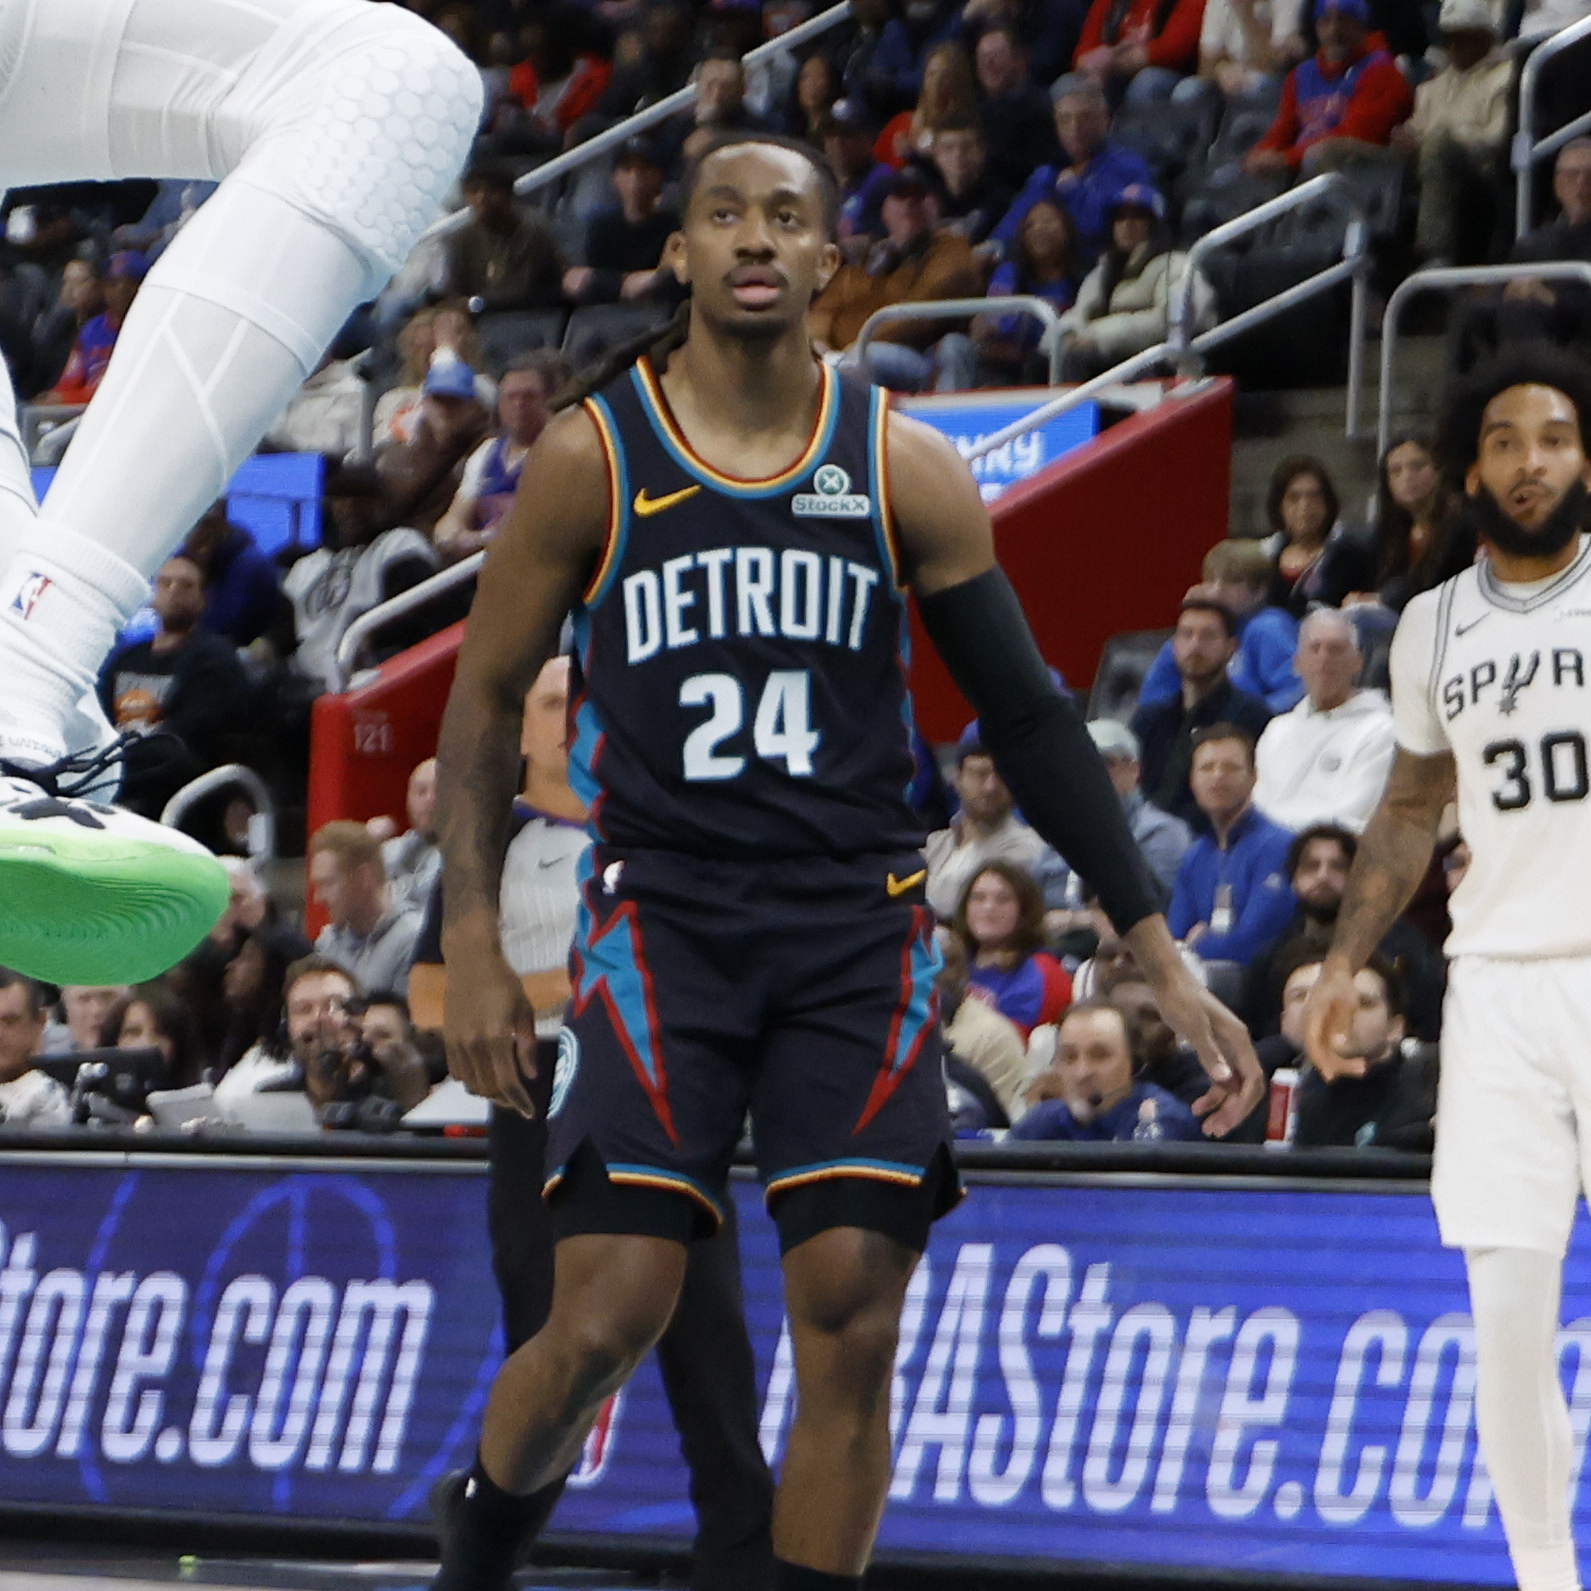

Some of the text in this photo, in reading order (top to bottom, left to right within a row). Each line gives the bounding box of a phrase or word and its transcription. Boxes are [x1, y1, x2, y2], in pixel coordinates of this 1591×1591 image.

[795, 497, 865, 512] StockX
[623, 546, 879, 666] DETROIT
[354, 723, 390, 753] 121
[678, 668, 822, 783] 24
[1483, 729, 1590, 811] 30
